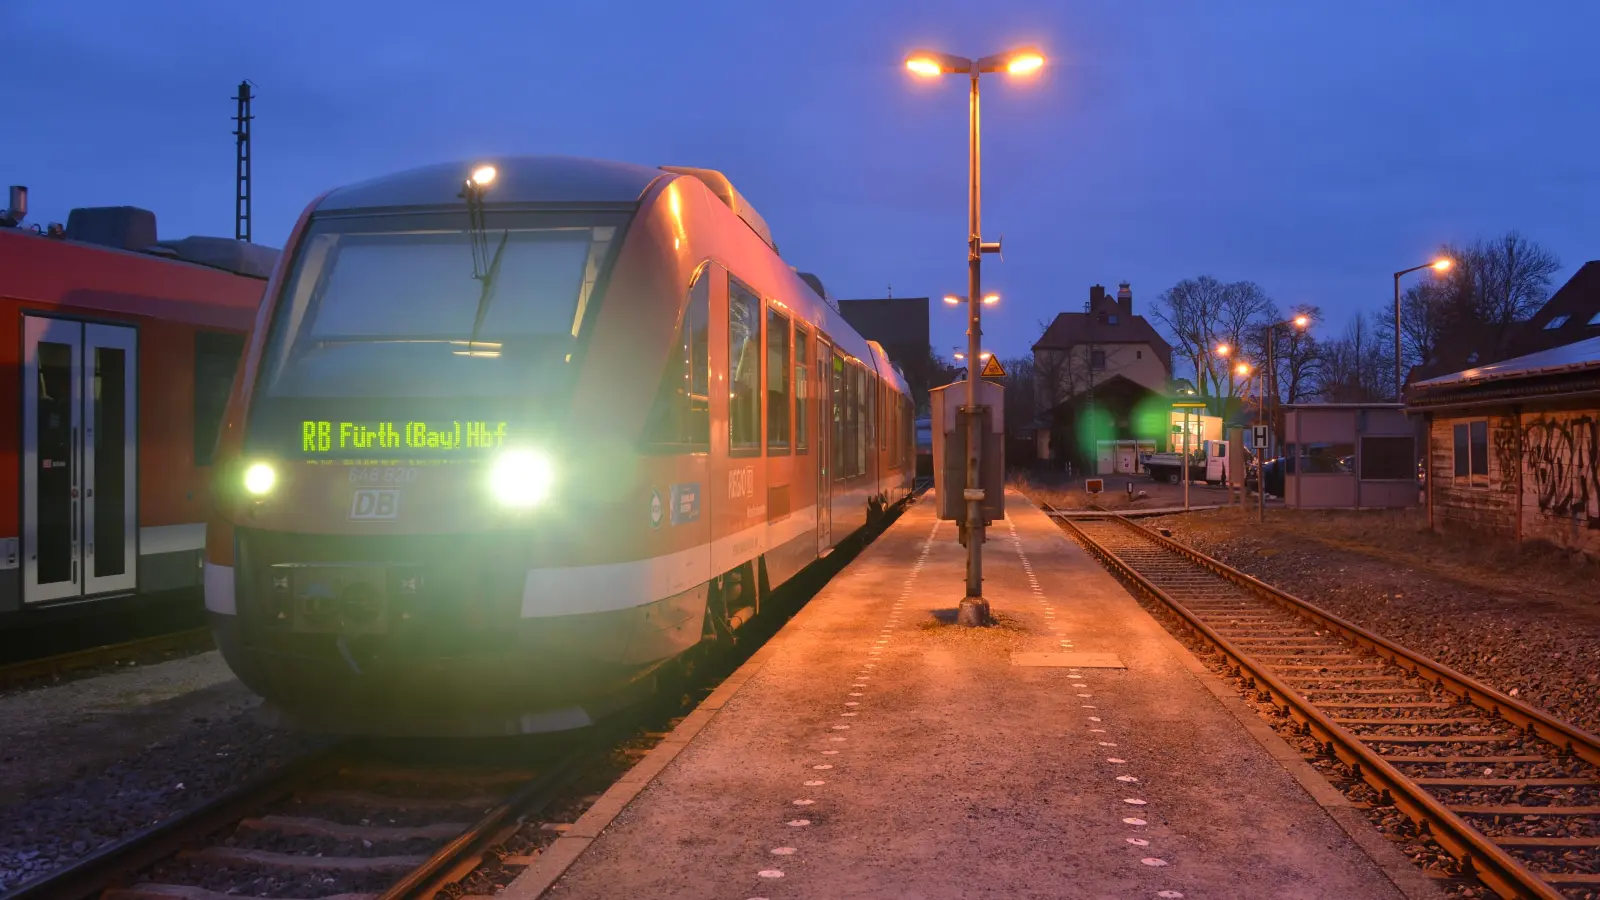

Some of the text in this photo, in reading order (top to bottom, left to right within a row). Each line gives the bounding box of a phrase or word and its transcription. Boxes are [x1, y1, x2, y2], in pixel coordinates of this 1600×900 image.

[303, 420, 507, 452] RB Fürth (Bay) Hbf
[1254, 426, 1267, 447] H
[351, 490, 400, 519] DB
